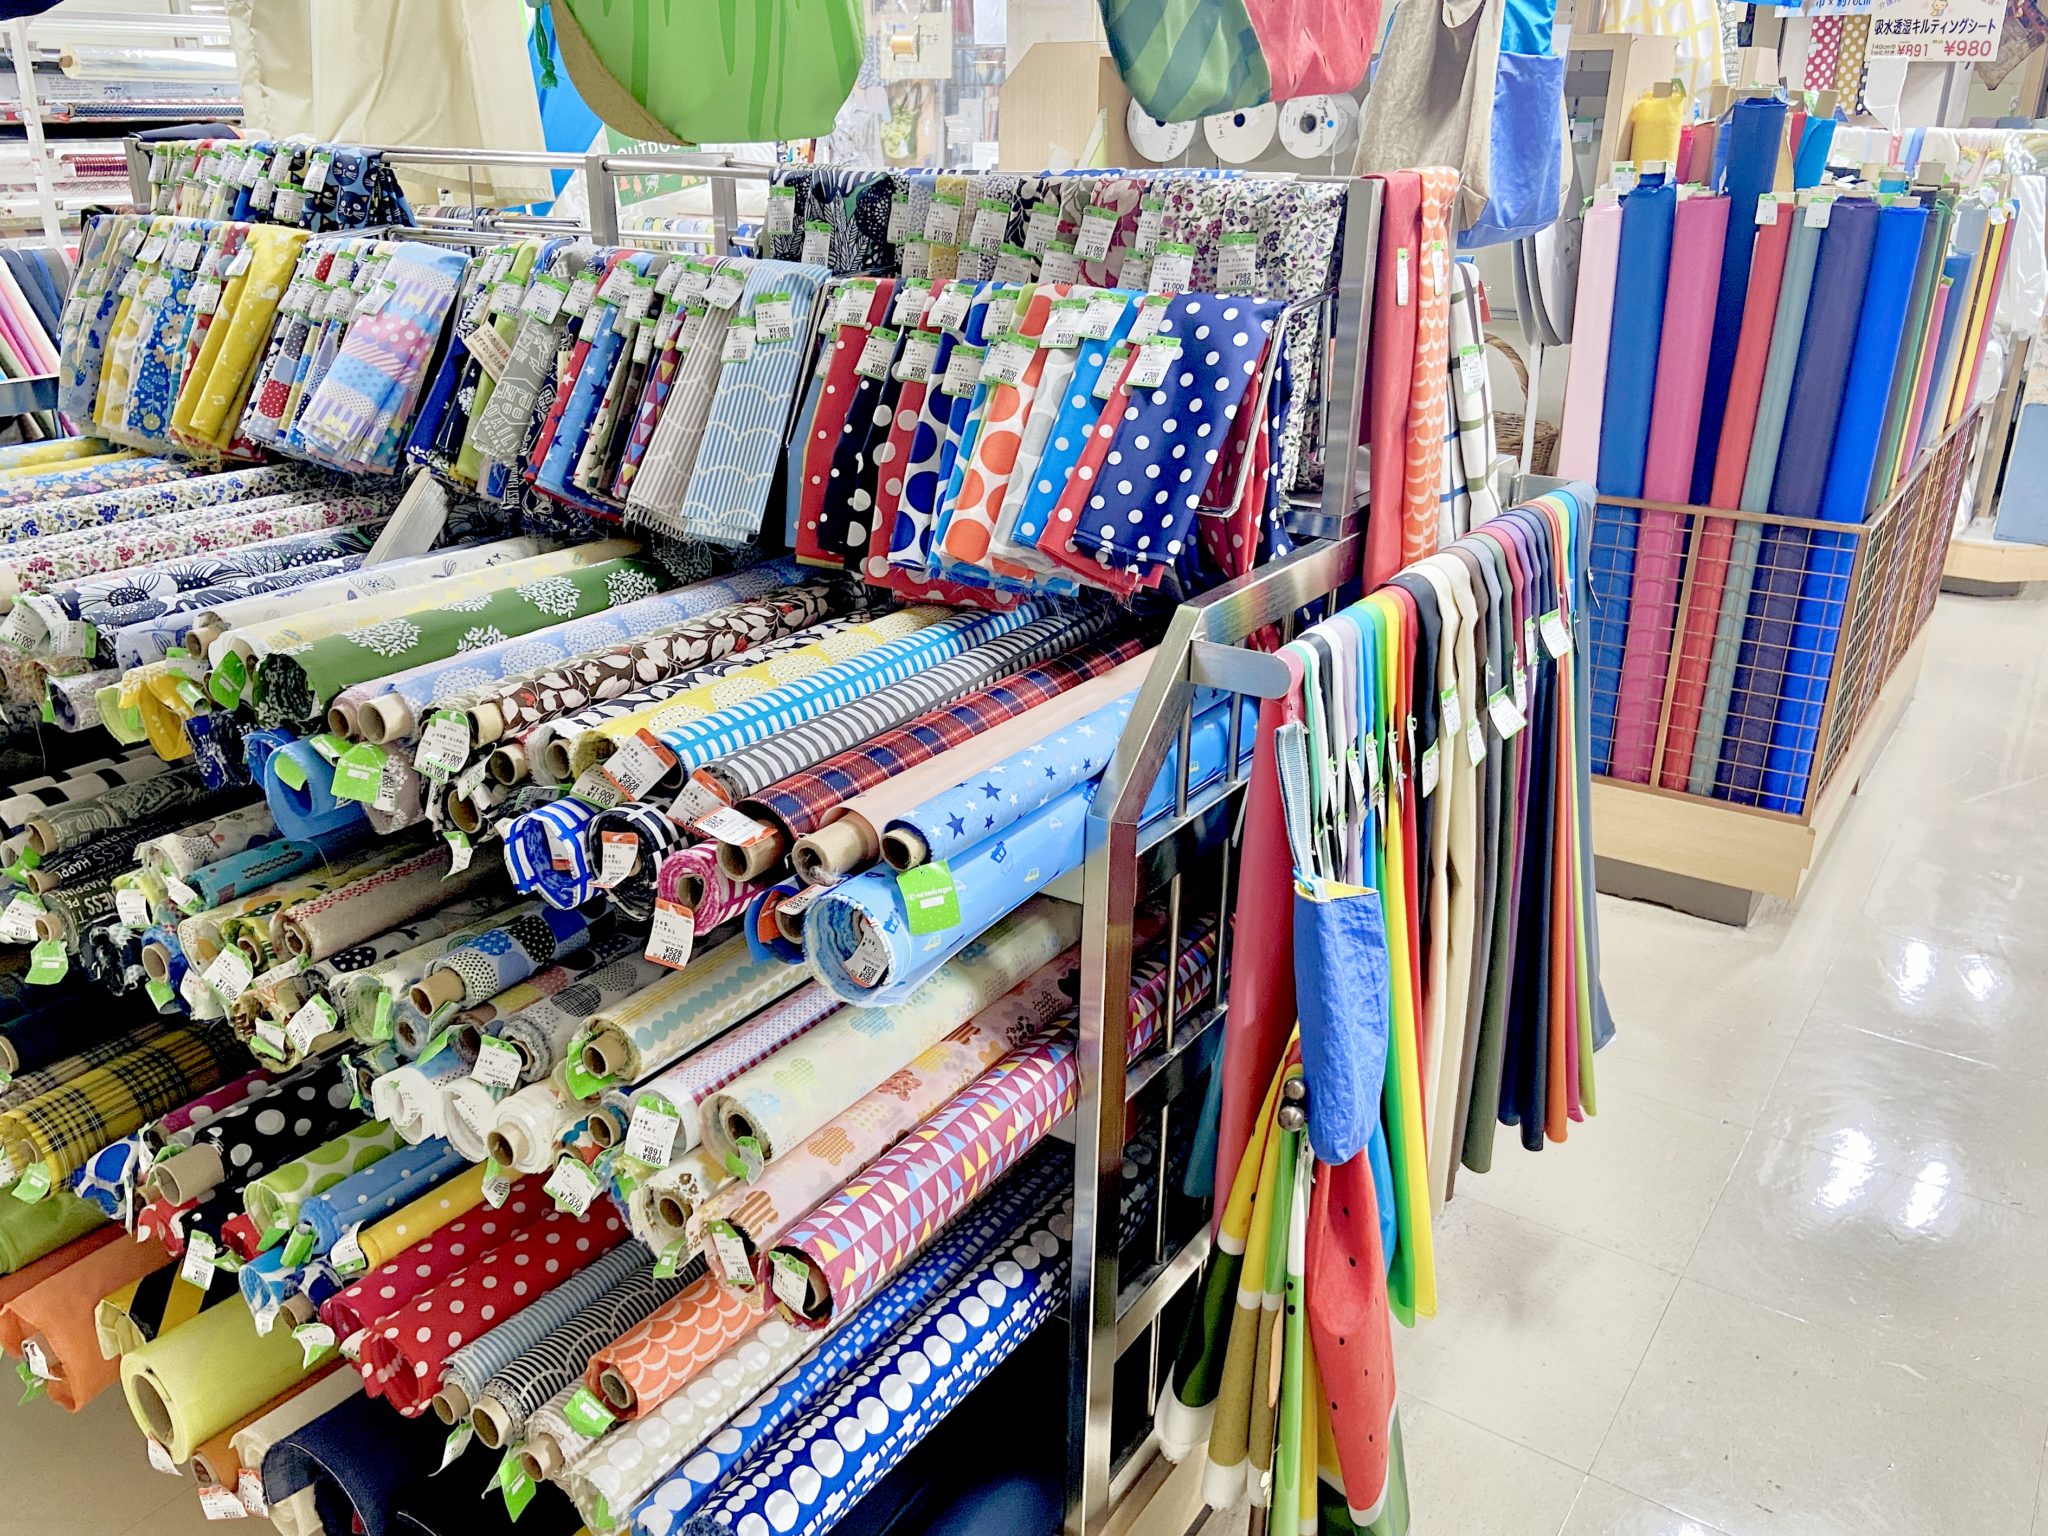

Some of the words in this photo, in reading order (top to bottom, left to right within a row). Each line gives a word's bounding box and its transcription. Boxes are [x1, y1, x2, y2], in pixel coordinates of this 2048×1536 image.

[1874, 18, 1996, 35] 吸水透湿キルティングシート
[1896, 43, 1929, 57] ¥891
[1943, 40, 1992, 57] ¥980
[1086, 244, 1105, 253] ¥1,000
[1162, 281, 1185, 290] ¥1,000
[1002, 368, 1017, 376] ¥800
[442, 752, 463, 764] ¥1,000
[617, 776, 636, 795] ¥580
[622, 772, 640, 790] ¥528
[586, 790, 611, 806] ¥1,100
[590, 784, 615, 800] ¥1,000
[665, 945, 683, 958] ¥528
[662, 952, 680, 965] ¥580
[863, 965, 878, 976] ¥528
[858, 972, 873, 984] ¥580
[644, 1145, 662, 1157] ¥891
[642, 1152, 662, 1164] ¥980
